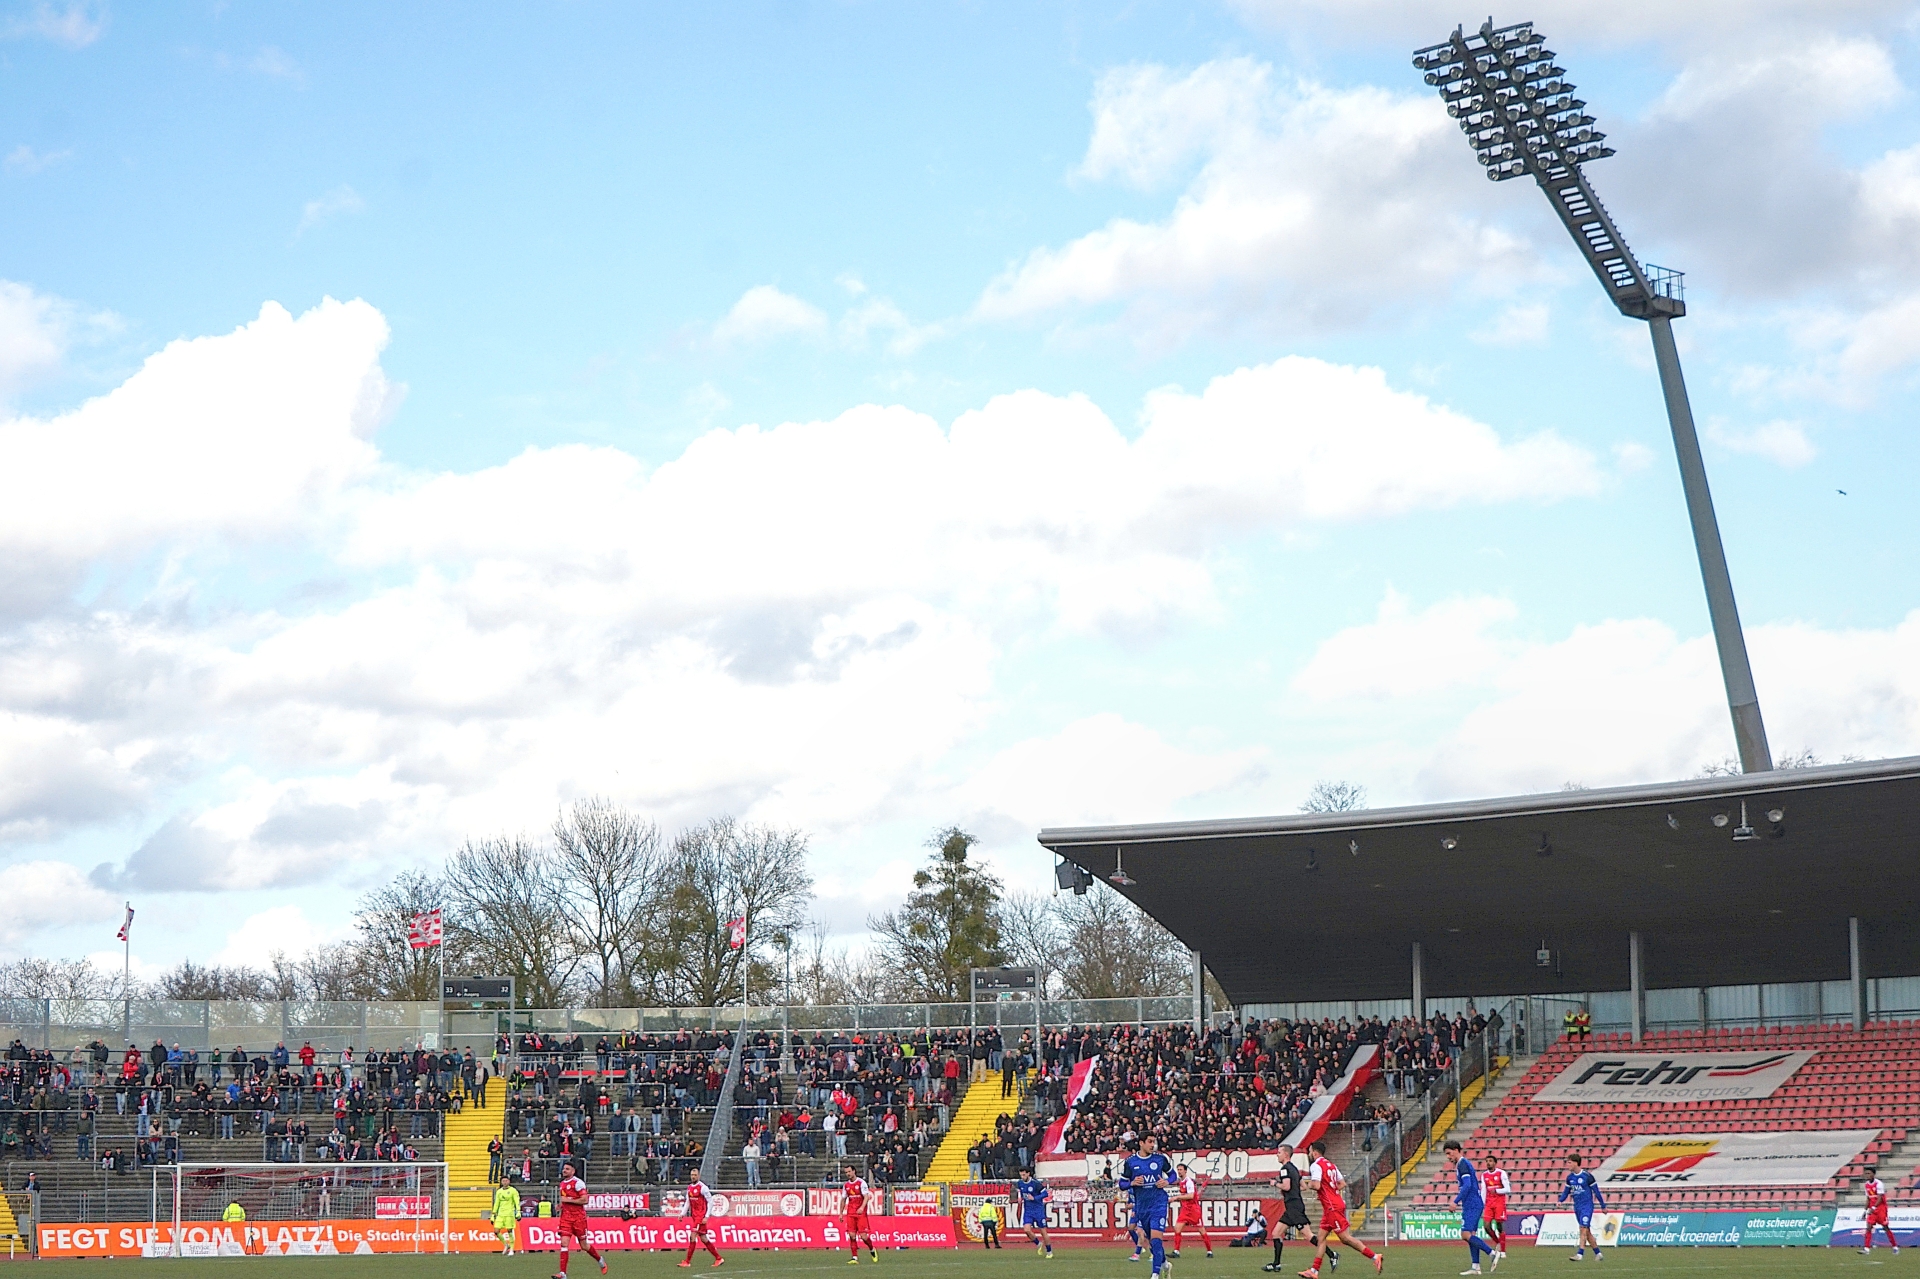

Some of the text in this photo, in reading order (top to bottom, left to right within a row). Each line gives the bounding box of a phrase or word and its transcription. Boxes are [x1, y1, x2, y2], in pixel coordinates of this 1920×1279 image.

[1571, 1060, 1713, 1085] Fehr
[1558, 1085, 1754, 1100] Fair in Entsorgung
[1651, 1140, 1712, 1148] Albert
[1085, 1150, 1197, 1181] BLK
[1604, 1173, 1697, 1182] BECK
[894, 1190, 937, 1203] VORSTADT
[952, 1196, 985, 1207] STARS
[735, 1203, 773, 1216] ON TOUR
[1005, 1202, 1108, 1228] KSELER
[1414, 1213, 1432, 1221] bringen
[1747, 1217, 1808, 1228] otto scheuerer
[41, 1228, 110, 1249] FEGT
[244, 1225, 333, 1247] PLATZ!
[337, 1229, 362, 1242] Die
[528, 1224, 812, 1244] Das eam für deie Finanzen.
[893, 1231, 947, 1244] Sparkasse
[1540, 1231, 1568, 1242] Tierpark
[1620, 1226, 1740, 1242] www.maler-kroenert.de
[1744, 1229, 1805, 1240] bautenschutz gmbh
